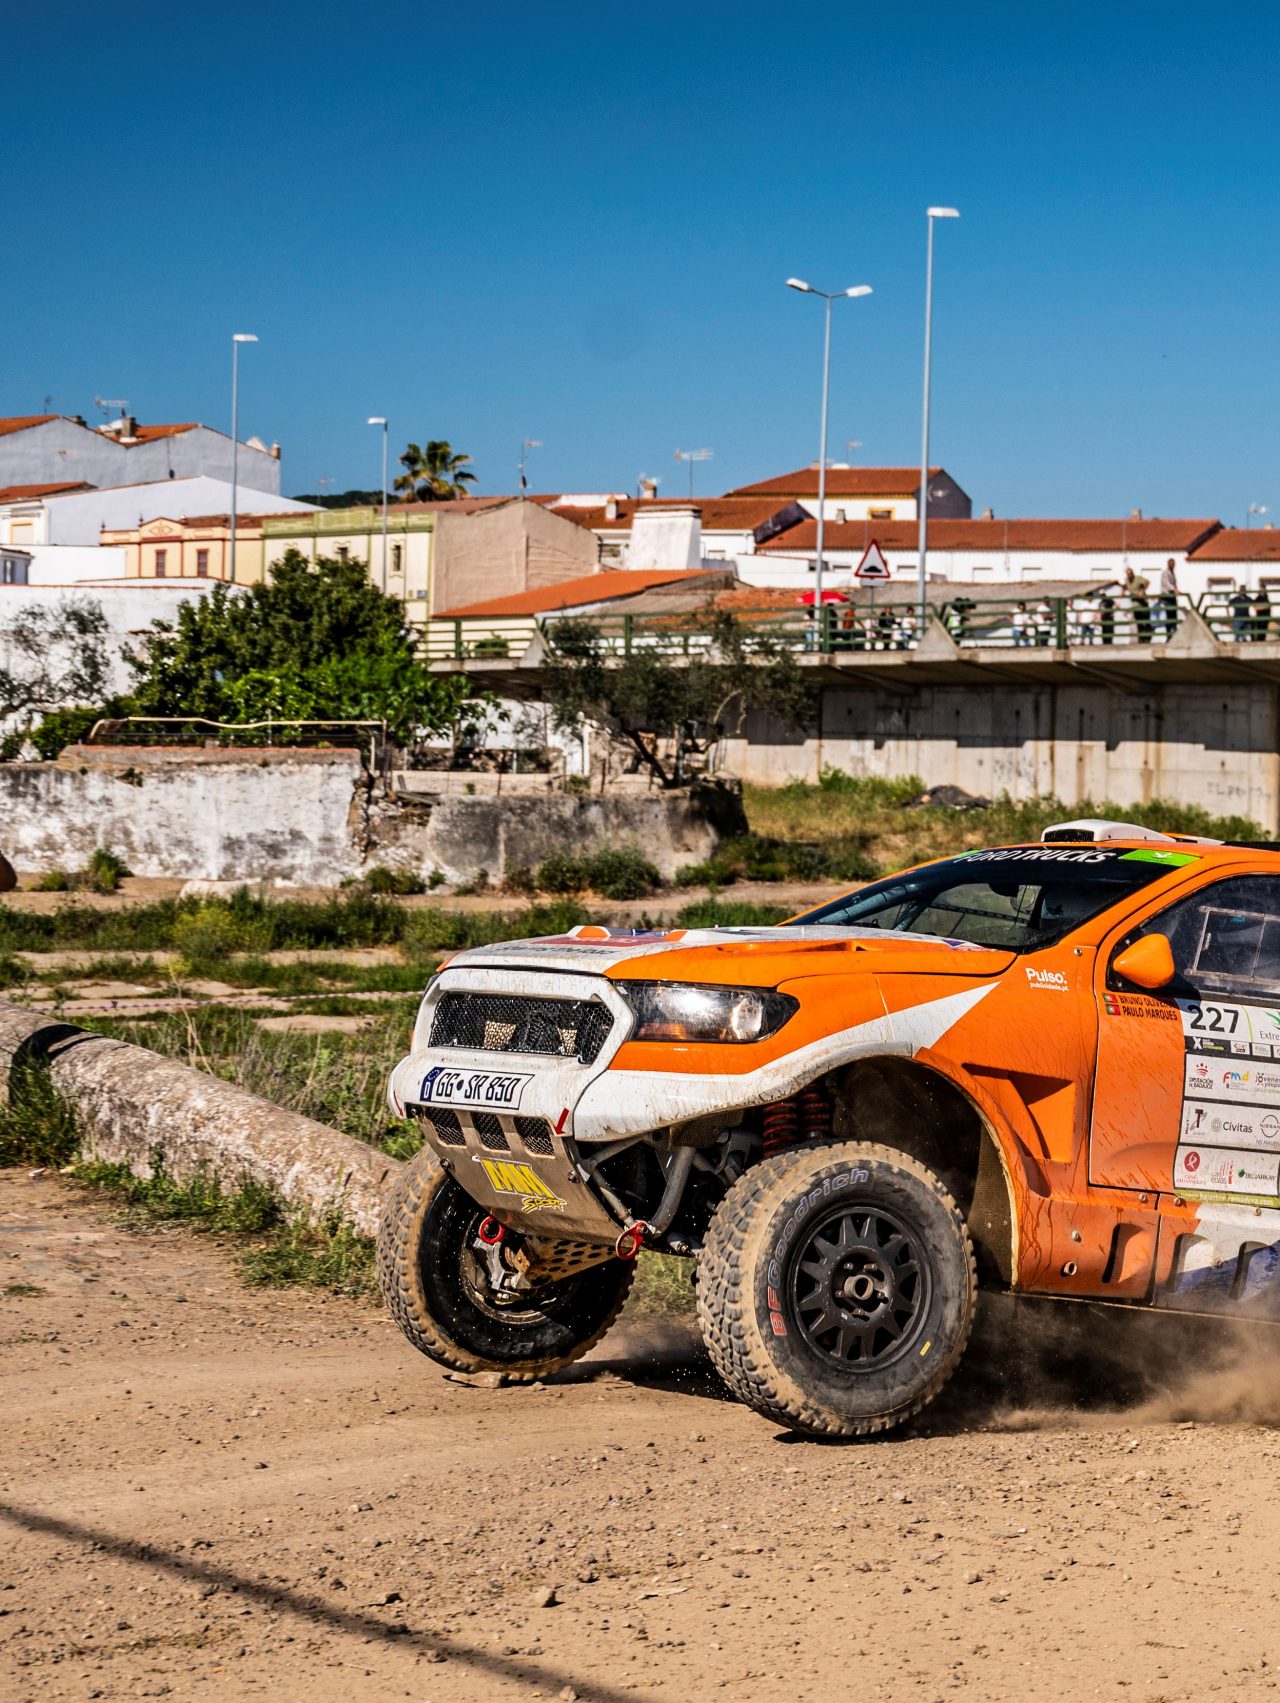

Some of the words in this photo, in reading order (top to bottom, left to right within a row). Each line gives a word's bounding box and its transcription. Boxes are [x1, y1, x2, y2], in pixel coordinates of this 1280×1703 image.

[1013, 849, 1117, 864] TRUCKS
[1119, 995, 1143, 1006] BRUNO
[1123, 1006, 1143, 1018] PAULO
[1145, 1008, 1178, 1021] MARQUES
[1187, 1004, 1239, 1034] 227
[424, 1081, 431, 1099] D
[436, 1072, 461, 1097] GG
[464, 1074, 490, 1100] SR
[485, 1076, 522, 1103] 850
[480, 1157, 558, 1200] MM
[767, 1168, 869, 1337] BFGoodrich
